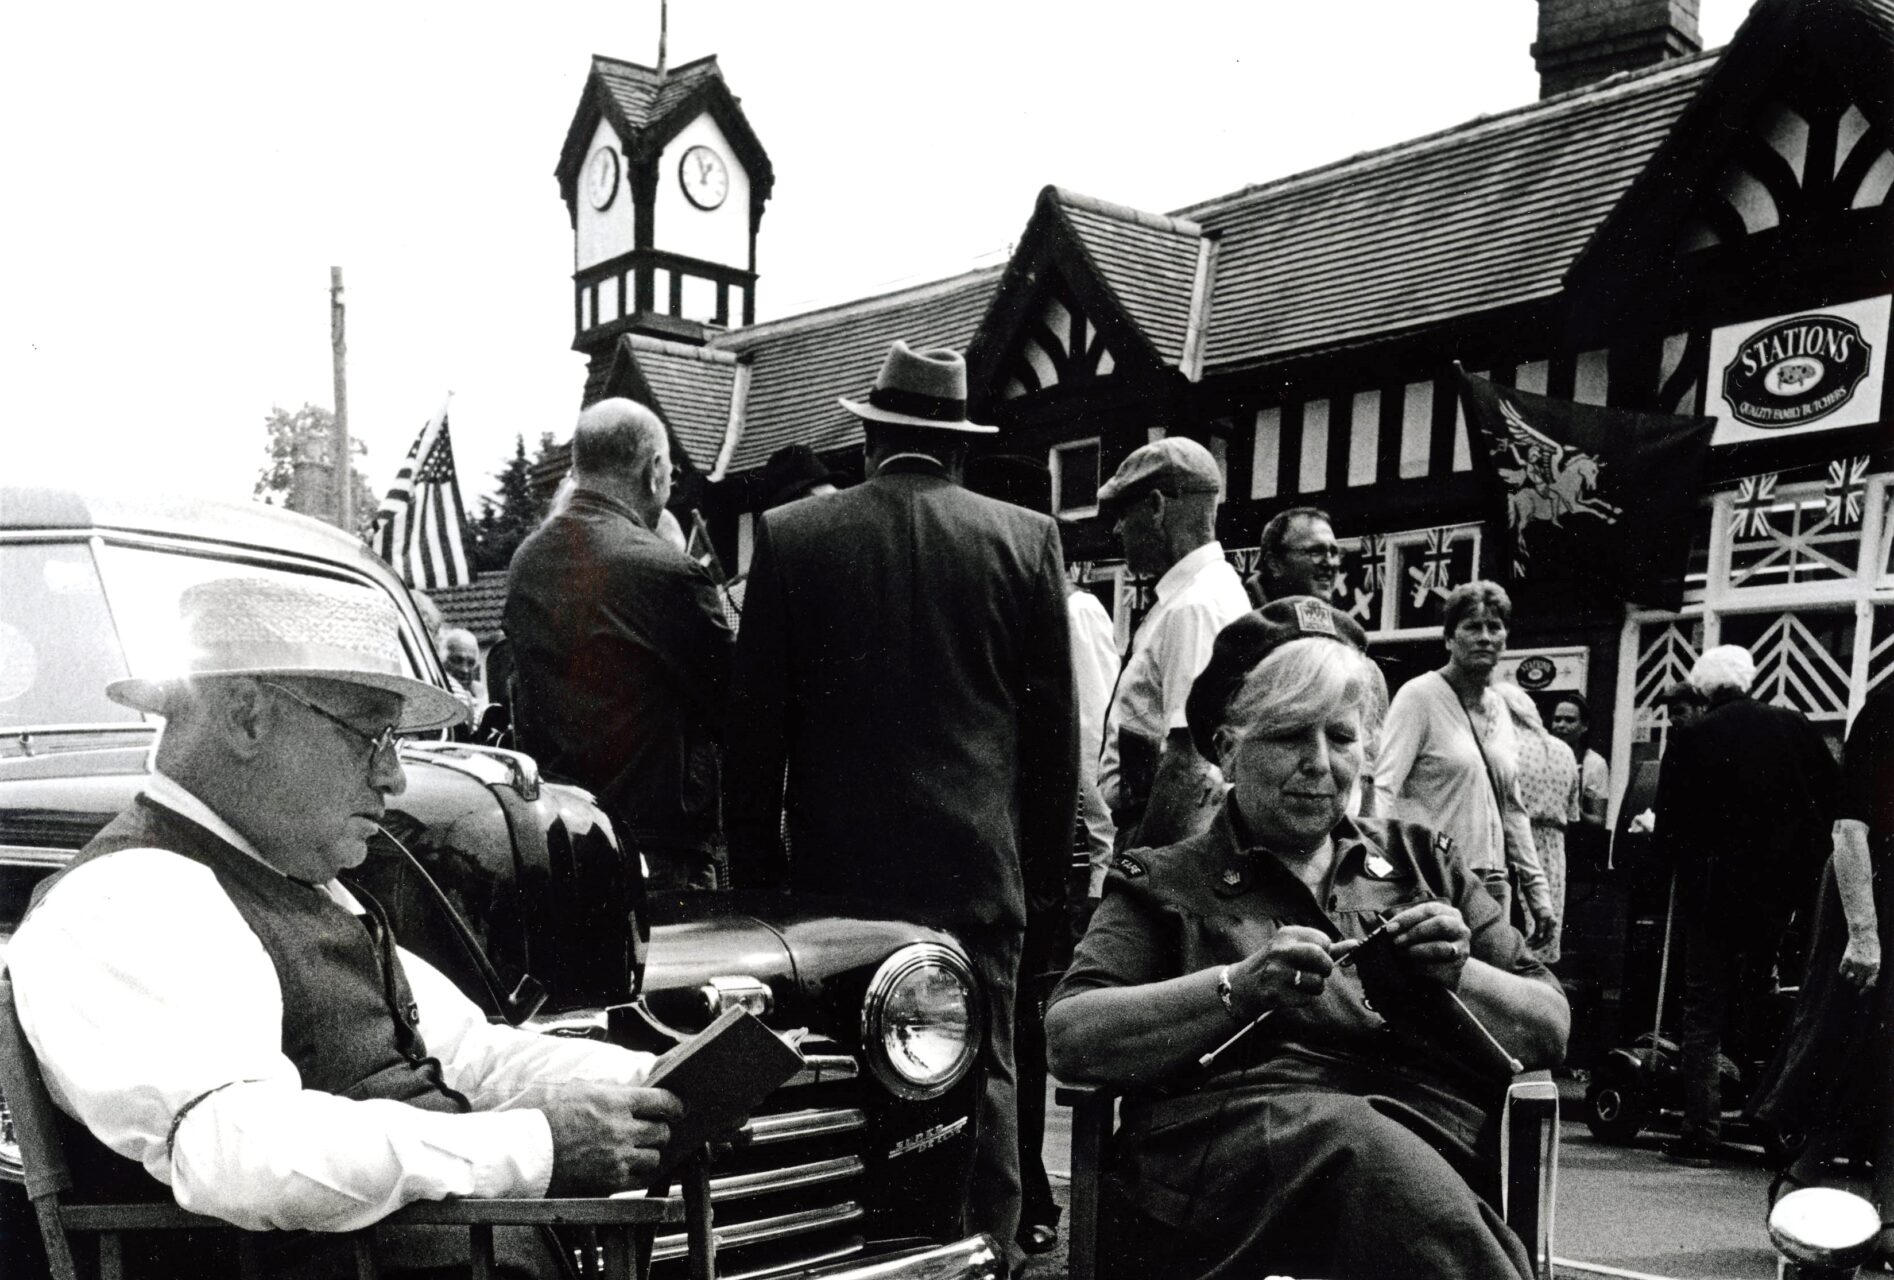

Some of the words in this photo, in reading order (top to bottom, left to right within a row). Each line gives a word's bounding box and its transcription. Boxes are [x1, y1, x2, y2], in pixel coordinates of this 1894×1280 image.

[1742, 326, 1855, 377] STATIONS
[1740, 402, 1772, 420] QUALITY
[1773, 406, 1800, 420] FAMILY
[1802, 387, 1847, 416] BUTCHERS
